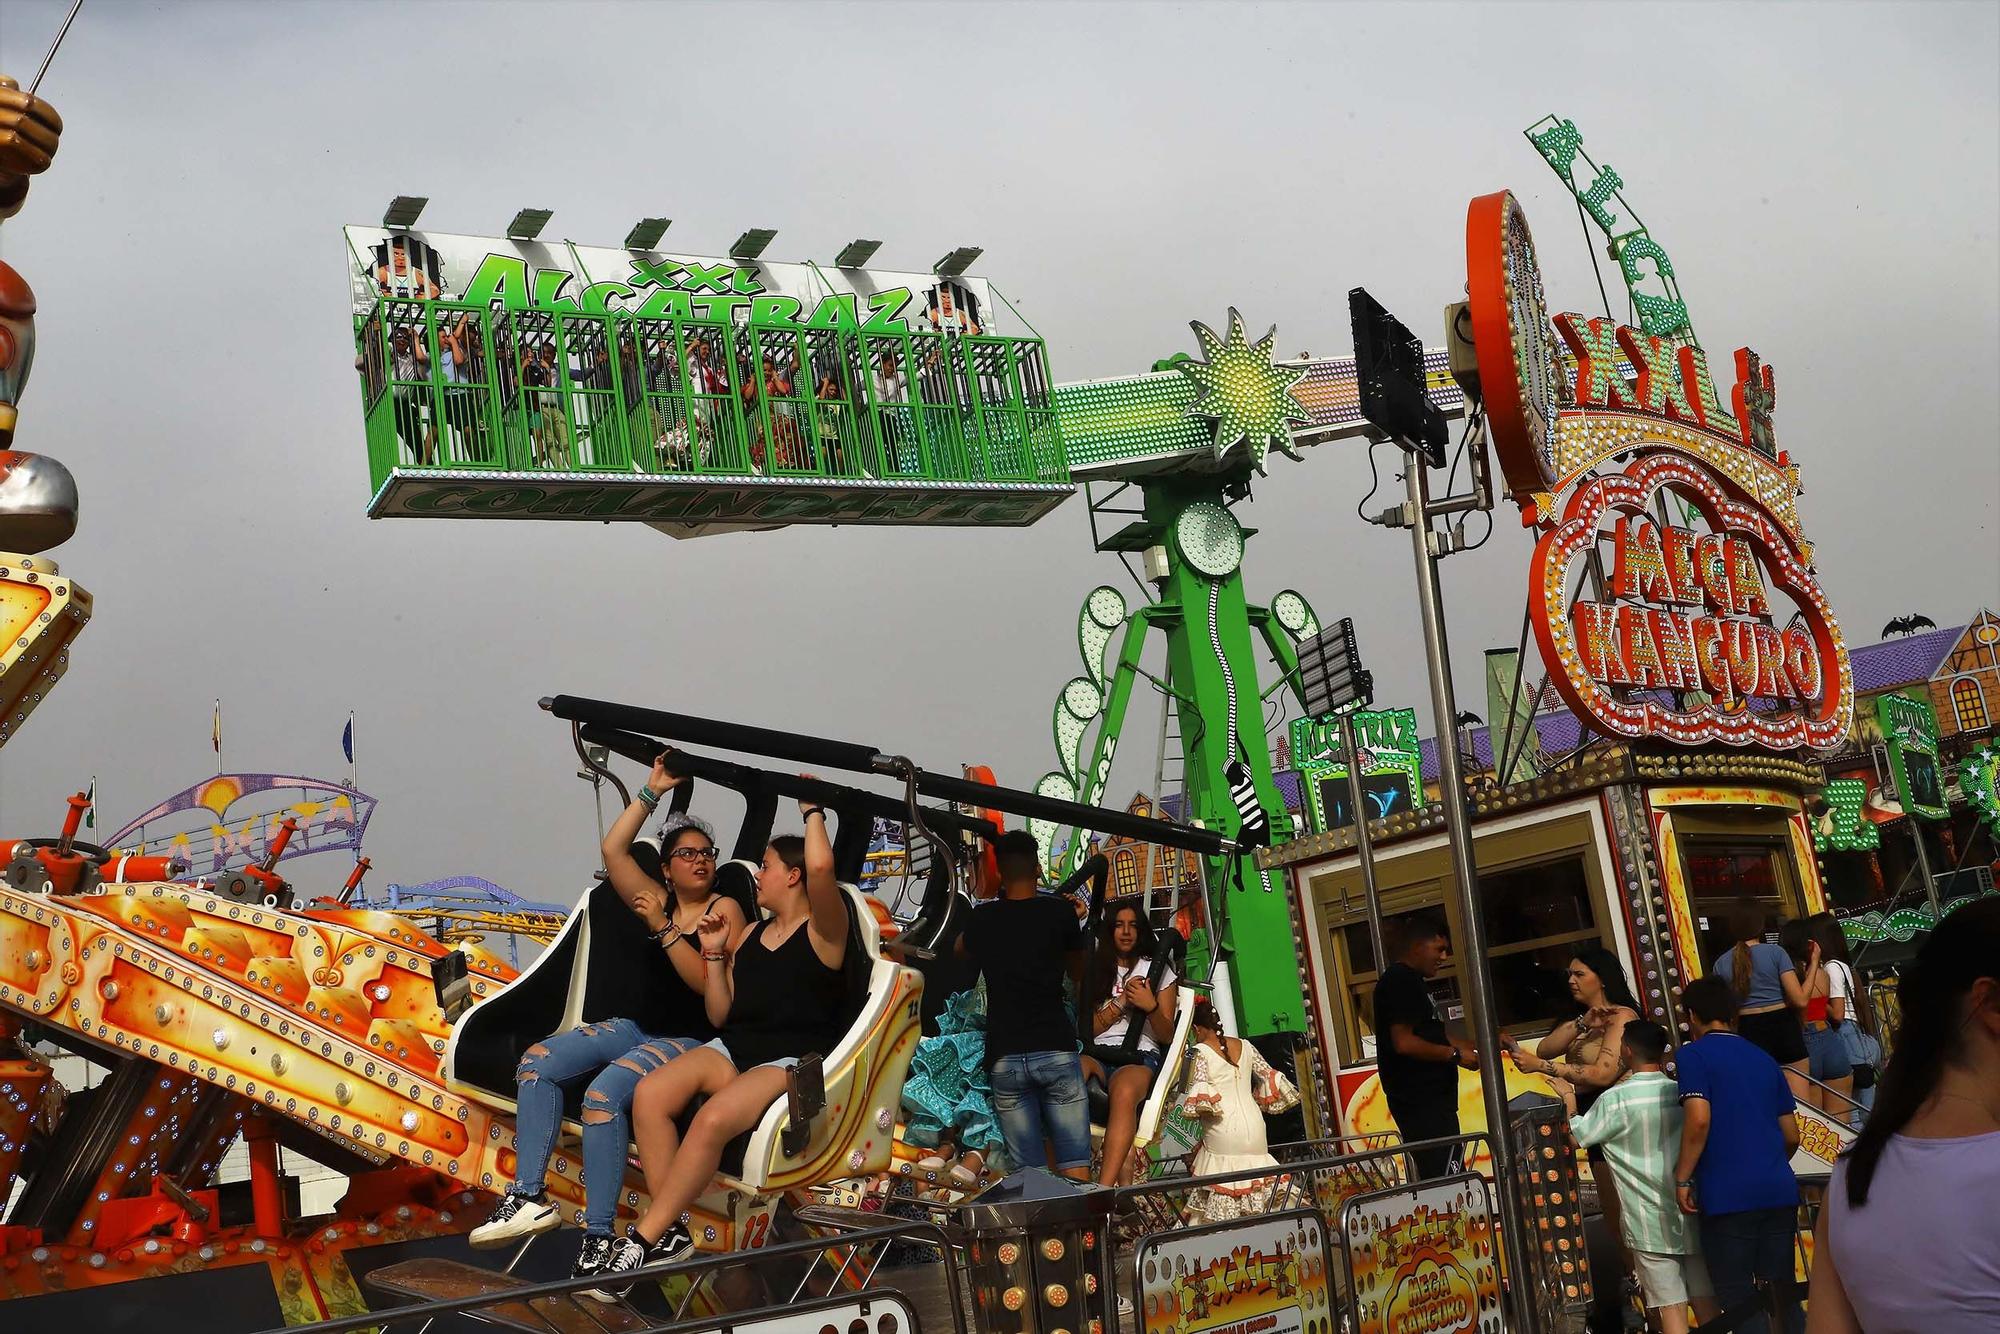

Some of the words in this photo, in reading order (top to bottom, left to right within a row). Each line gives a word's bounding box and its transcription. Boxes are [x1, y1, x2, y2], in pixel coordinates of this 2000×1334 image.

[461, 252, 912, 332] ALCATRAZ
[627, 258, 767, 295] XXL
[1552, 311, 1744, 441] XXL
[403, 486, 1057, 521] COMANDANTE
[1613, 514, 1774, 618] MEGA
[1573, 599, 1822, 704] KANGURO
[740, 1212, 770, 1250] 12
[1398, 1204, 1446, 1256] XXL
[1209, 1245, 1272, 1307] XXL
[1407, 1268, 1452, 1308] MEGA
[1395, 1293, 1467, 1334] KANGURO
